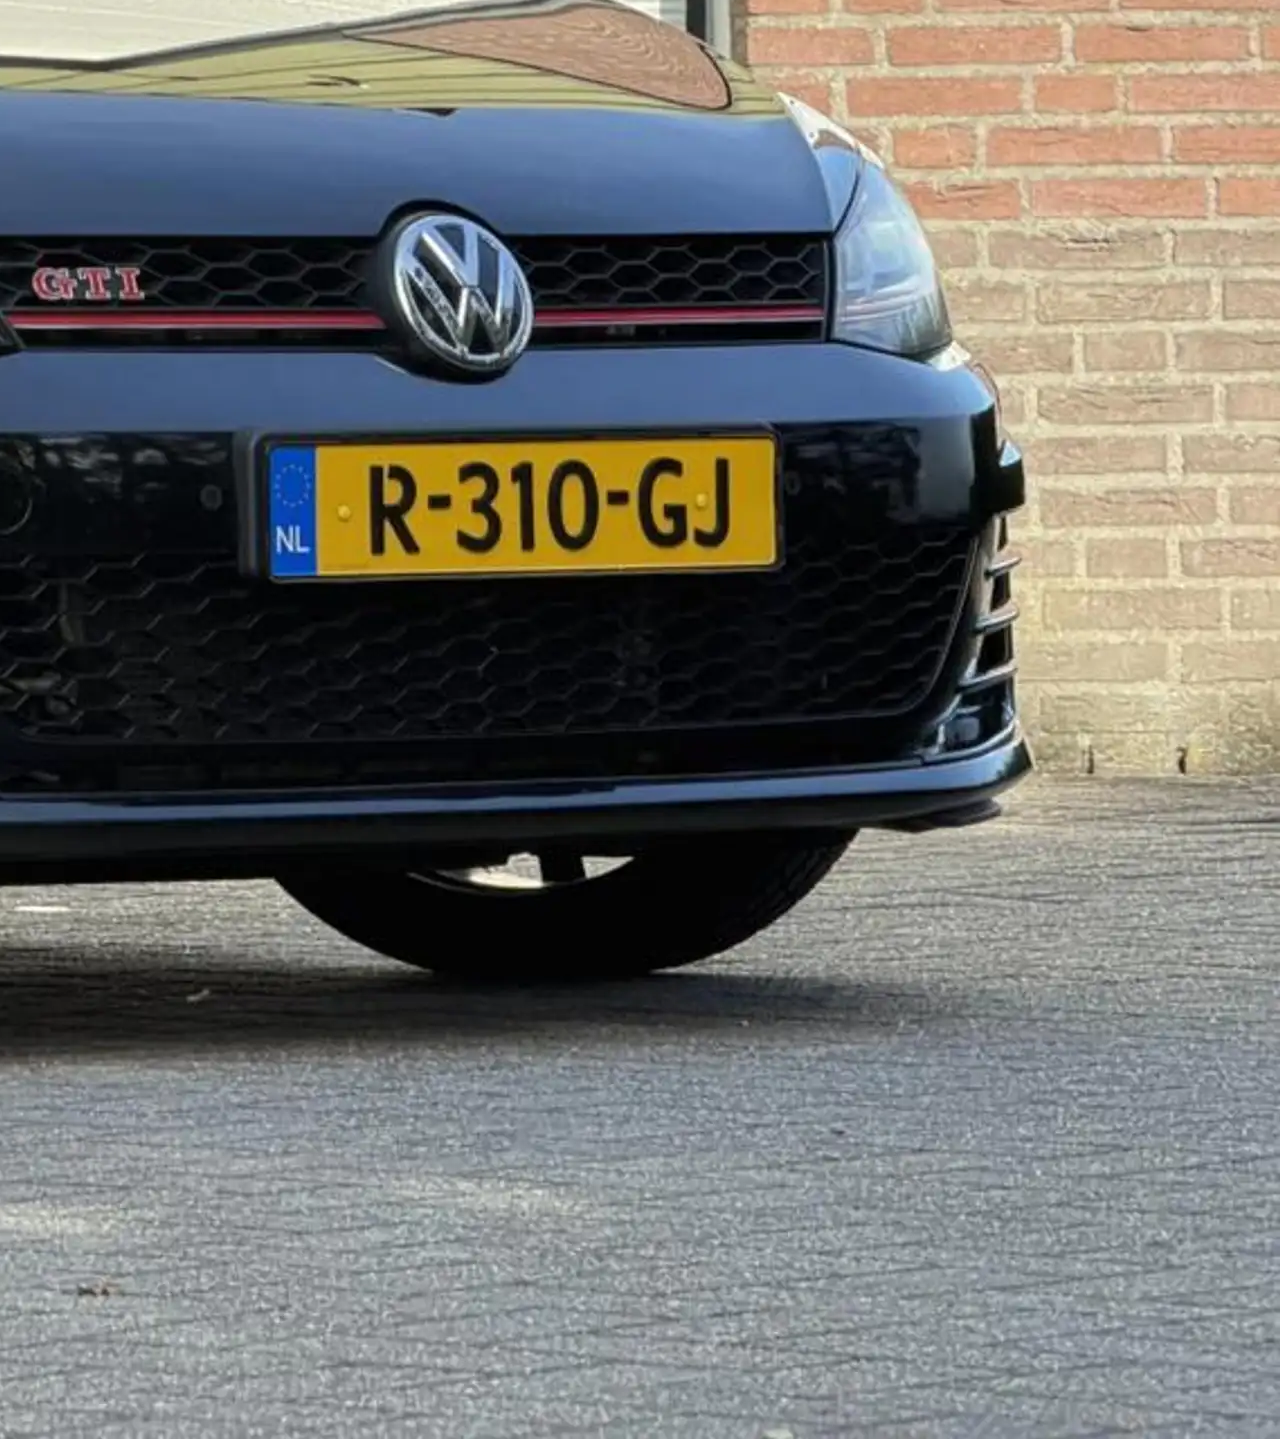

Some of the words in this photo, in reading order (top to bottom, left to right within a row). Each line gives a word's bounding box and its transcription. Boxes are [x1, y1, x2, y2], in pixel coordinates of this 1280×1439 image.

[31, 266, 145, 302] GTI
[367, 457, 733, 557] R-310-GJ
[275, 525, 311, 556] NL
